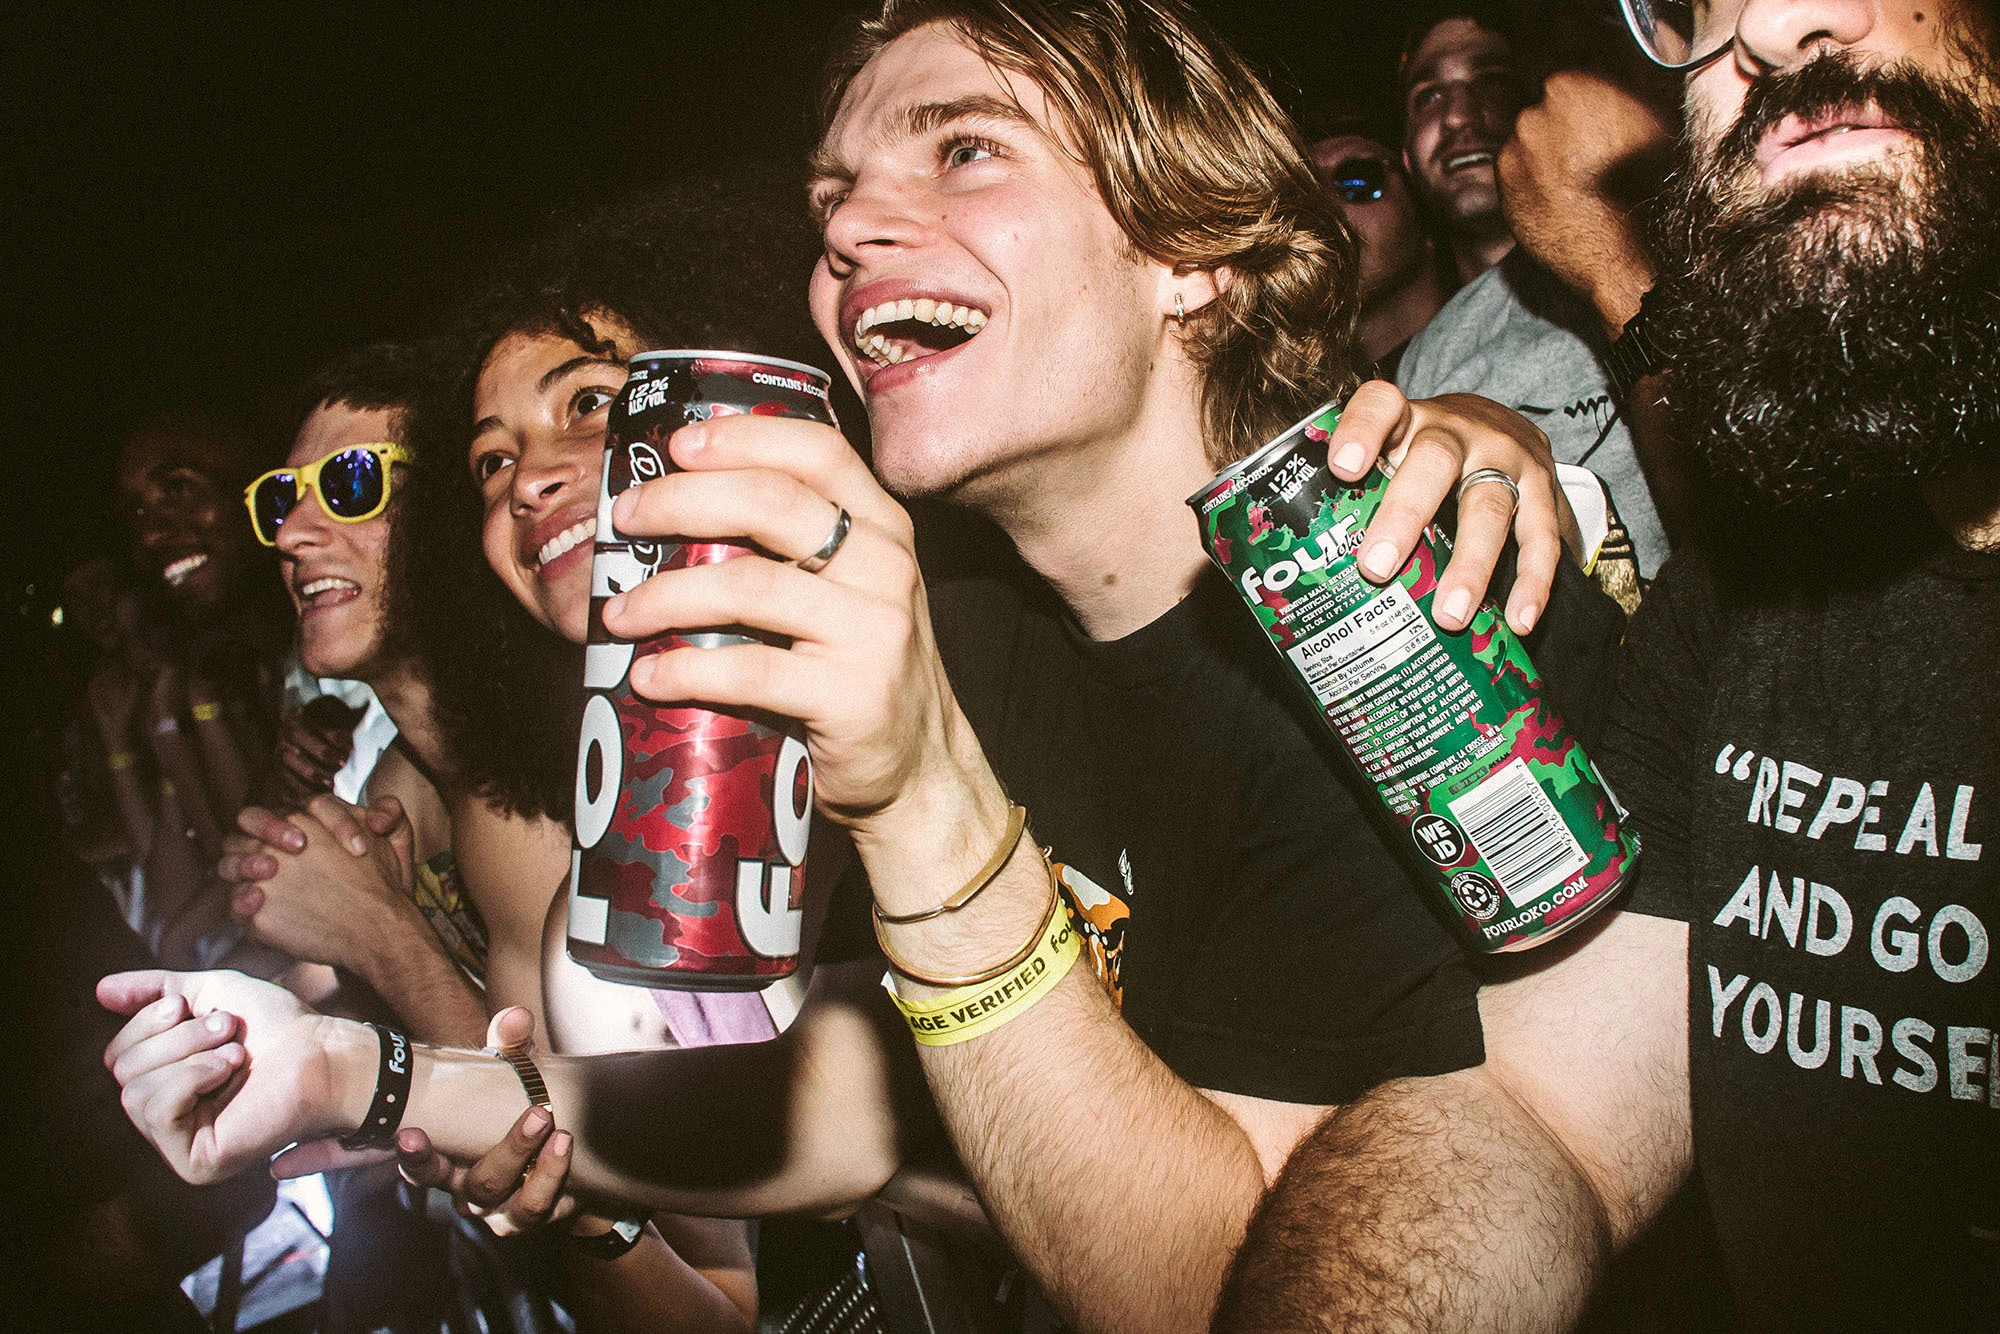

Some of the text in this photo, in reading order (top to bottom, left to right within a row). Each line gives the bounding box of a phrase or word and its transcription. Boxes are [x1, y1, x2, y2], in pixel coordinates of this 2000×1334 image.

[628, 376, 669, 400] 12%
[752, 372, 801, 391] CONTAINS
[1200, 461, 1274, 514] CONTAINS ALCOHOL
[1268, 453, 1307, 493] 12%
[1240, 513, 1357, 605] four
[1278, 594, 1309, 615] PREMIUM
[1307, 582, 1328, 598] MALT
[1279, 612, 1296, 625] WITH
[1294, 590, 1332, 616] ARTIFICIAL
[1301, 583, 1361, 623] CERTIFIED COLOR
[1333, 604, 1344, 614] PT
[1343, 597, 1355, 608] 7.5
[1354, 591, 1365, 600] FL
[1299, 593, 1397, 660] Alcohol Facts
[1303, 660, 1321, 672] Serving
[1320, 653, 1333, 664] Size
[1308, 666, 1329, 679] Servings
[1327, 660, 1338, 669] Per
[1337, 644, 1365, 663] Container
[1316, 622, 1423, 691] Alcohol By Volume 12%
[1326, 642, 1443, 717] GOVERNMENT WARNING: (1) ACCORDING
[1327, 683, 1349, 698] Alcohol
[1348, 676, 1361, 687] Per
[1359, 662, 1387, 681] Serving
[1420, 633, 1429, 641] oz
[1333, 717, 1342, 727] TO
[1348, 701, 1375, 719] SURGEON
[1373, 685, 1403, 707] GENERAL,
[1401, 667, 1429, 689] WOMEN
[1426, 651, 1450, 672] SHOULD
[1366, 701, 1399, 723] ALCOHOLIC
[1398, 678, 1434, 705] BEVERAGES
[1433, 661, 1457, 682] DURING
[1372, 736, 1383, 746] (2)
[1382, 711, 1427, 741] CONSUMPTION
[1426, 704, 1438, 715] OF
[1438, 679, 1471, 707] ALCOHOLIC
[1374, 714, 1399, 732] BECAUSE
[1398, 708, 1409, 718] OF
[1408, 700, 1422, 713] THE
[1421, 690, 1438, 704] RISK
[1436, 683, 1447, 694] OF
[1445, 670, 1464, 687] BIRTH
[1358, 689, 1478, 764] BEVERAGES IMPAIRS YOUR ABILITY TO DRIVE
[1380, 757, 1390, 767] OR
[1390, 744, 1415, 763] OPERATE
[1415, 721, 1454, 749] MACHINERY,
[1453, 710, 1470, 725] AND
[1468, 699, 1484, 714] MAY
[1384, 762, 1405, 777] HEALTH
[1403, 745, 1438, 768] PROBLEMS.
[1426, 772, 1447, 788] UNDER
[1448, 757, 1472, 776] SPECIAL
[1473, 732, 1506, 760] AGREEMENT,
[1428, 753, 1458, 775] COMPANY,
[1456, 748, 1466, 759] LA
[1464, 733, 1488, 753] CROSSE,
[1526, 780, 1551, 813] 00107
[735, 735, 813, 958] fo
[1416, 818, 1452, 845] WE
[1432, 838, 1458, 860] ID
[1547, 813, 1573, 846] 95216
[1482, 875, 1589, 940] FOURLOKO.COM
[1713, 865, 1989, 983] AND GO
[909, 922, 1072, 1031] AGE VERIFIED fou
